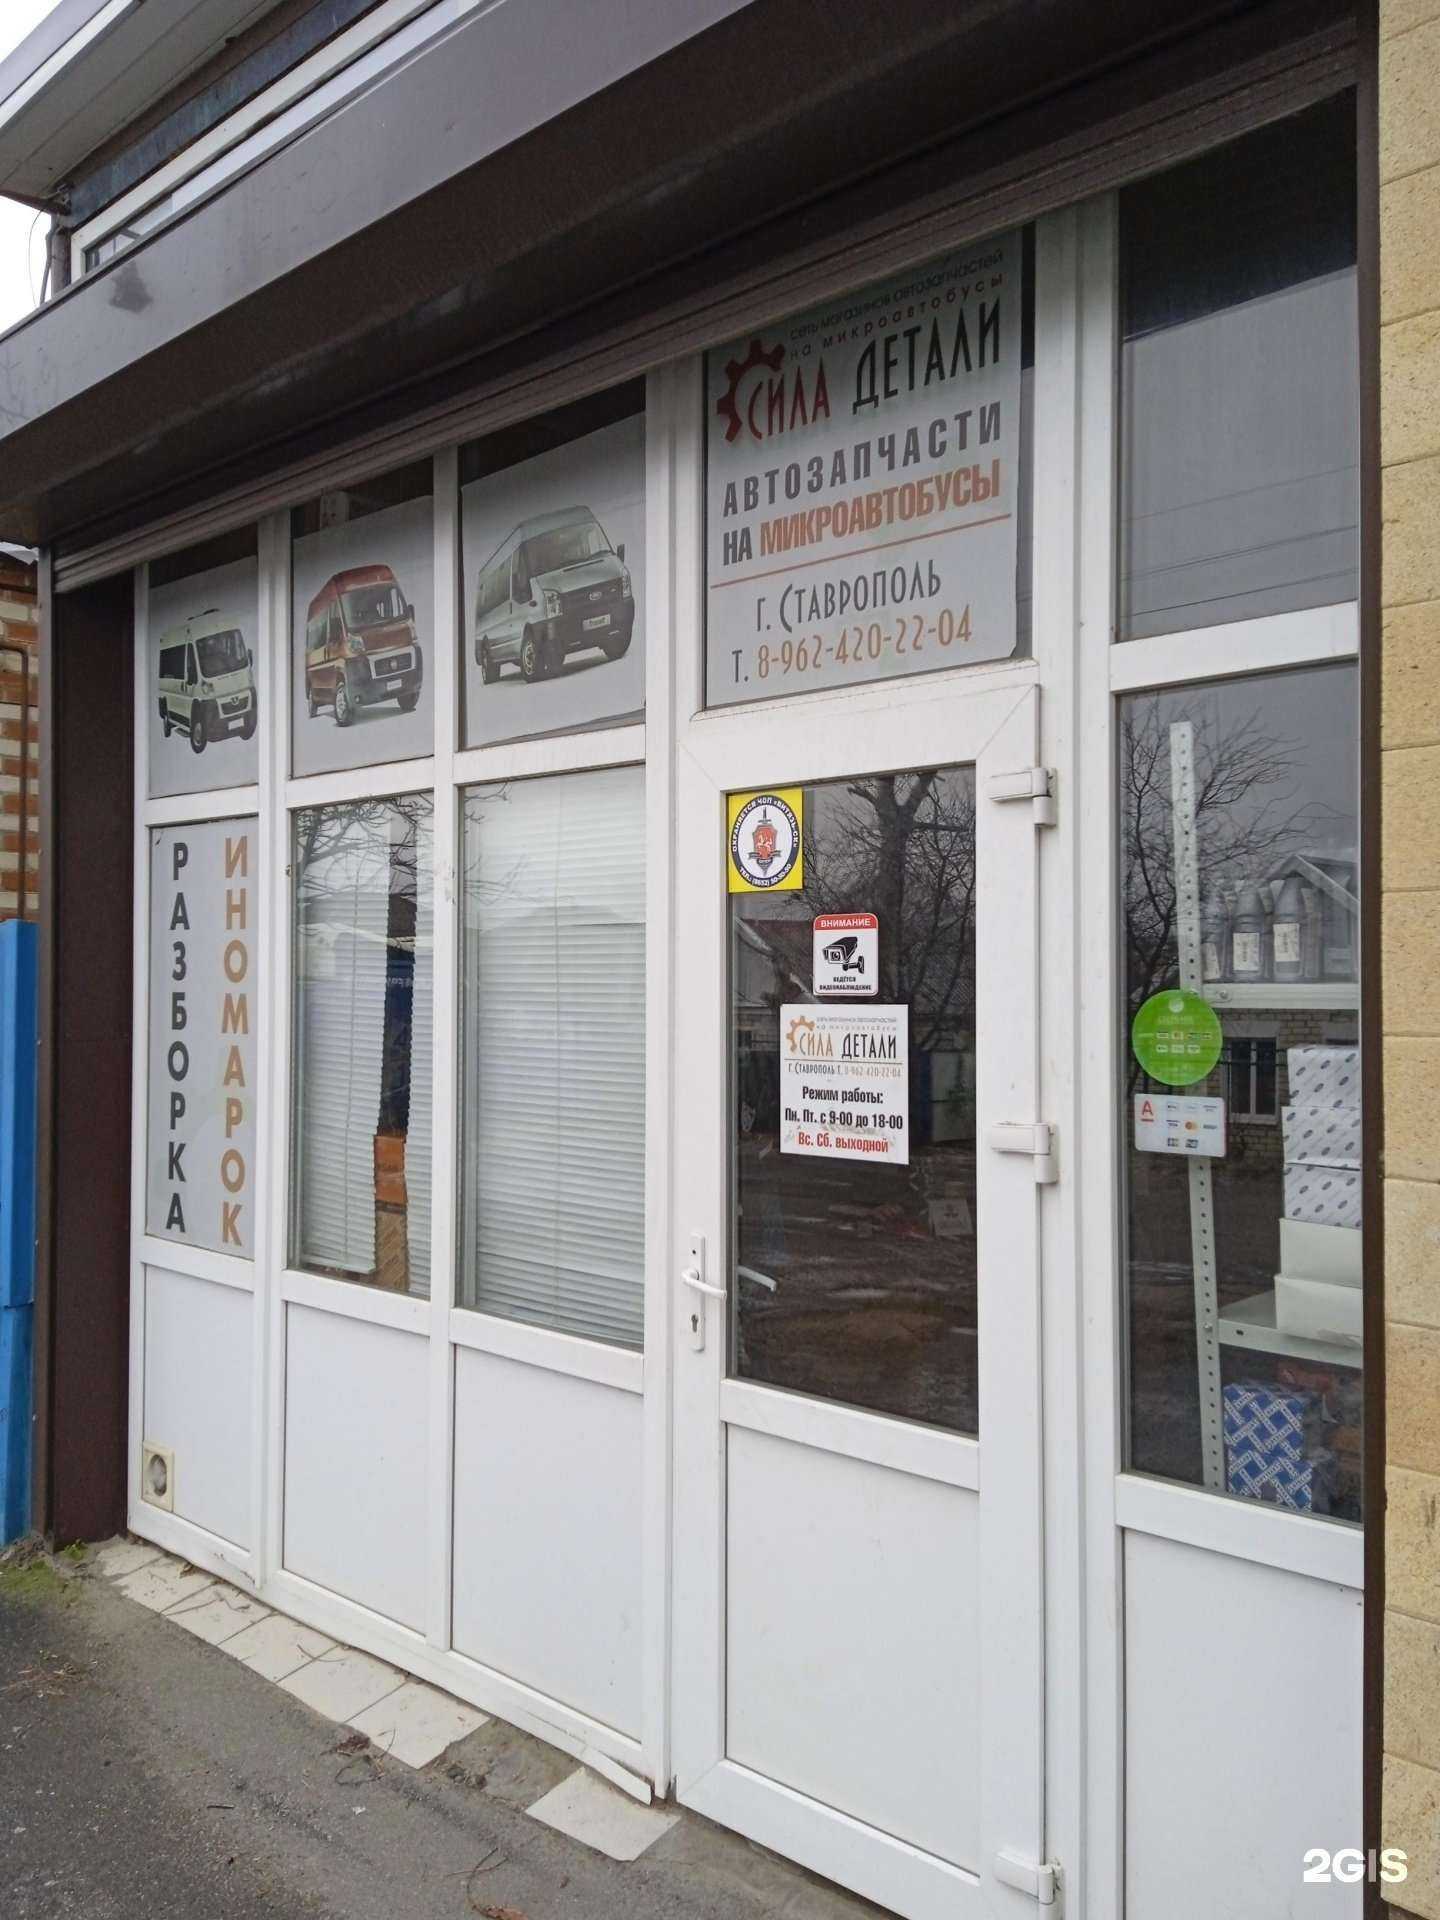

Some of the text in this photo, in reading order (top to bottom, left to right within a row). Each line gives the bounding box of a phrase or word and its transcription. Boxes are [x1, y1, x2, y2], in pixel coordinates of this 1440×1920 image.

[823, 274, 1004, 348] микроавтобусы
[748, 297, 1000, 440] СИЛА ДЕТАЛИ
[722, 400, 1001, 517] АВТОЗАПЧАСТИ
[722, 458, 1001, 566] НА МИКРОАВТОБУСЫ
[731, 603, 973, 683] Т. 8-962-420-22-04
[820, 918, 872, 928] ВНИМАНИЕ
[165, 841, 191, 1234] РАЗБОРКА
[220, 835, 250, 1248] ИНОМАРОК
[799, 1032, 897, 1060] СИЛА ДЕТАЛИ
[785, 1108, 904, 1130] Пн. Пт. с 9-00 до 18-00
[802, 1086, 884, 1104] Режим работы:
[798, 1131, 889, 1153] Вс. Сб. выходной
